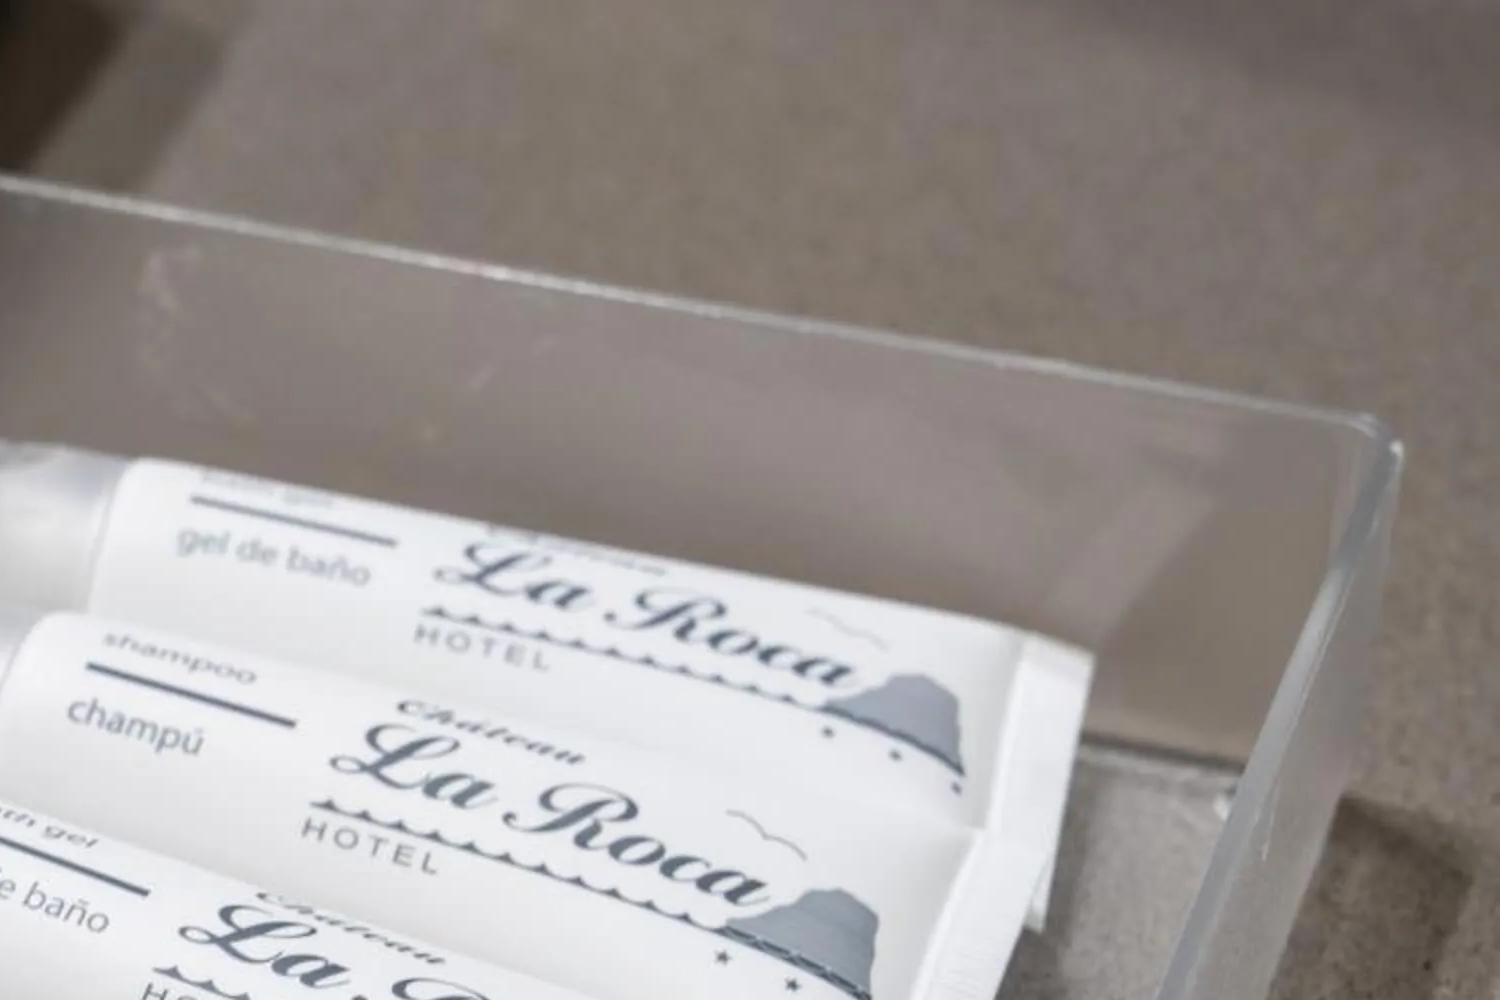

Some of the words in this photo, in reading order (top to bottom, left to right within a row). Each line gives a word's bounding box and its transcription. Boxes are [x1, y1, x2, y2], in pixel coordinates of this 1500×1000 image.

[433, 540, 594, 612] La
[602, 586, 864, 687] Roca
[102, 632, 258, 685] shampoo
[412, 622, 551, 673] HOTEL
[67, 696, 205, 758] champú
[43, 824, 100, 849] gel
[328, 722, 500, 810] La
[501, 782, 772, 907] Roca
[300, 816, 439, 875] HOTEL
[21, 880, 111, 934] baño
[177, 903, 352, 990] La
